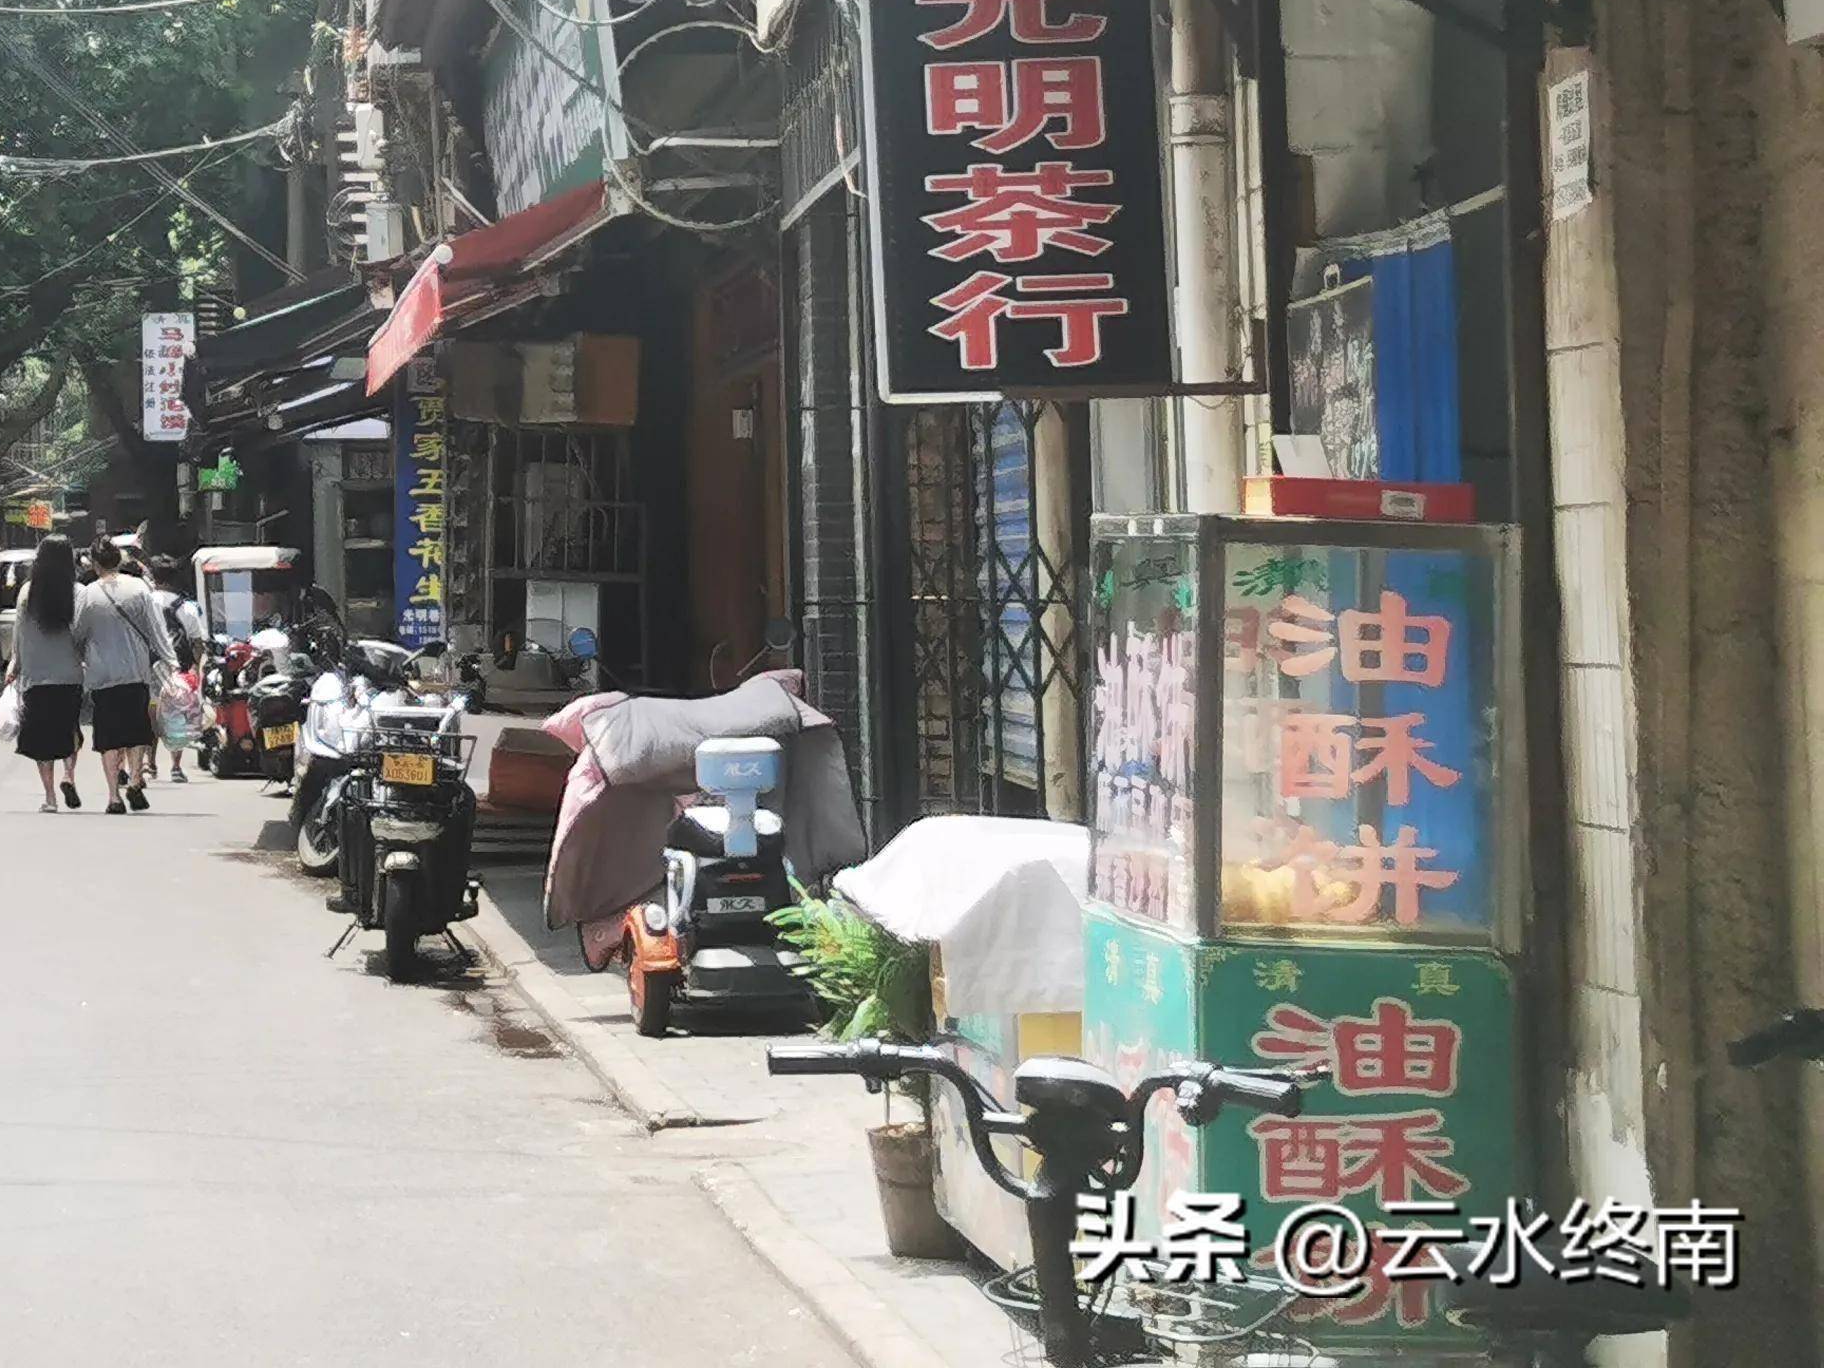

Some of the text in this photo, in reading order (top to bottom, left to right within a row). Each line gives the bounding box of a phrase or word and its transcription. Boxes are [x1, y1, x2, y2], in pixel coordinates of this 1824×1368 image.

[1268, 589, 1462, 925] 油酥饼
[1253, 958, 1461, 997] 清真
